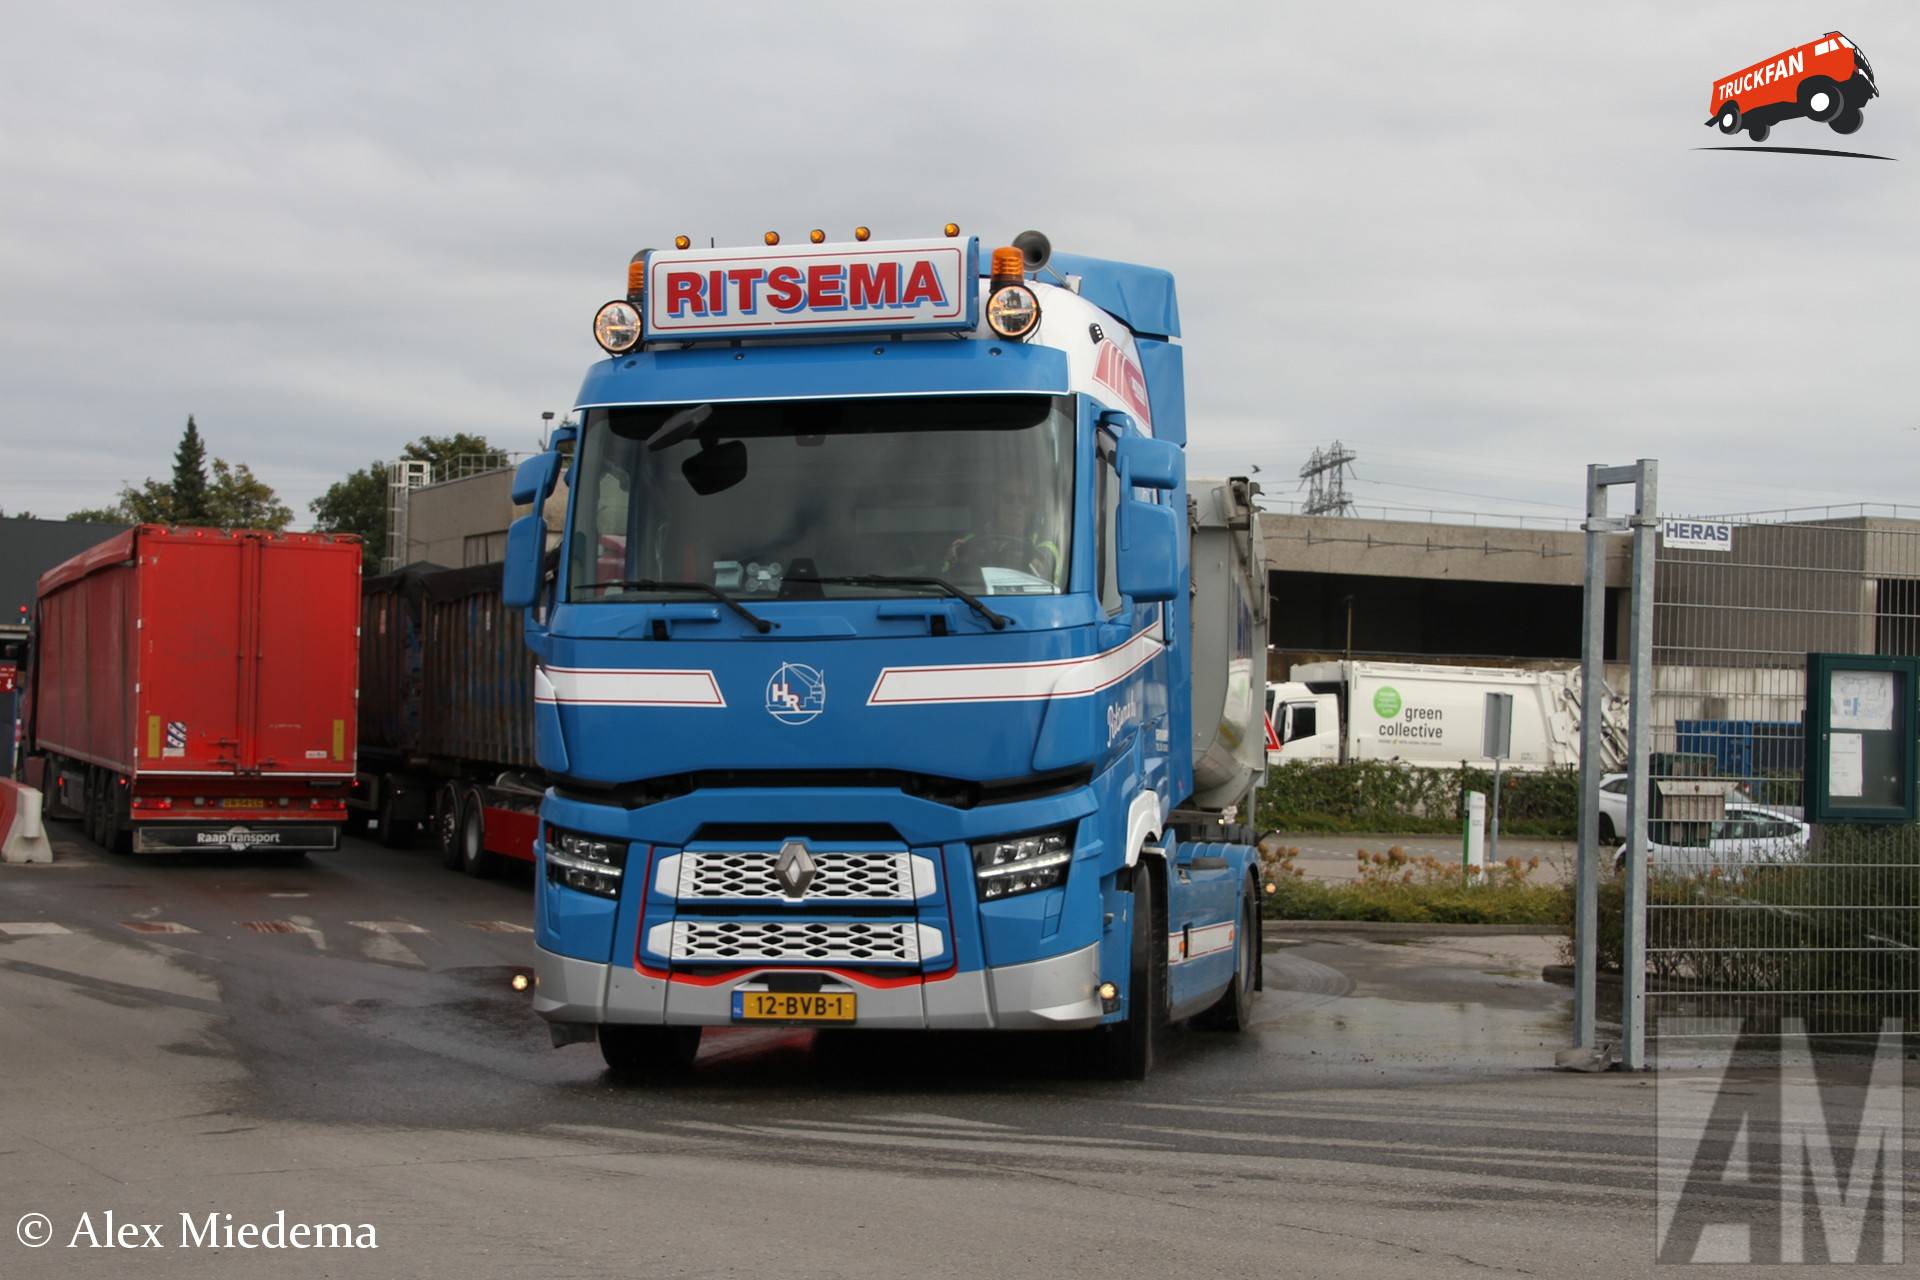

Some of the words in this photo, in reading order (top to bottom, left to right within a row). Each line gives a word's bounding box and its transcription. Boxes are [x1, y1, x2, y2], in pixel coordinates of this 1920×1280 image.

[667, 260, 949, 319] RITSEMA
[1666, 522, 1729, 541] HERAS
[1405, 707, 1443, 722] green
[1379, 722, 1443, 738] collective
[757, 996, 842, 1015] 12-BVB-1
